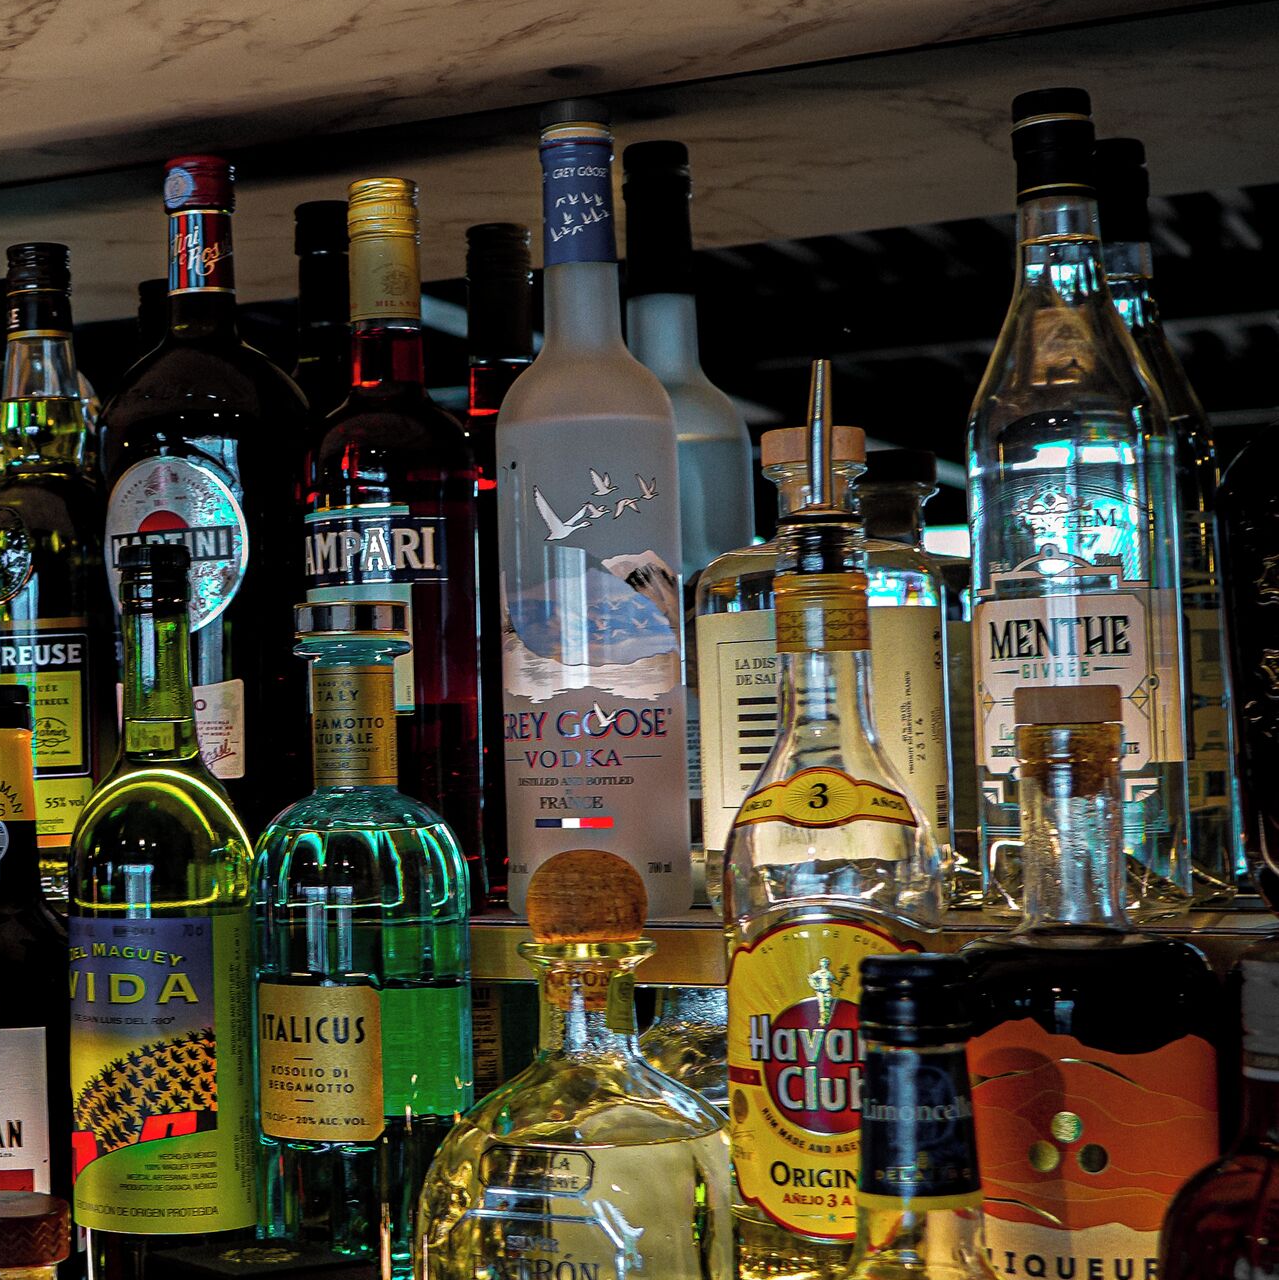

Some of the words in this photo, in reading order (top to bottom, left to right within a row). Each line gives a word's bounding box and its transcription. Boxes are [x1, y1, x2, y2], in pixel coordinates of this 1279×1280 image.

[552, 167, 575, 179] GREY
[113, 529, 228, 565] MINI
[989, 615, 1132, 660] MENTHE
[735, 658, 752, 670] LA
[736, 674, 752, 686] DE
[557, 709, 669, 742] GOOSE
[524, 750, 623, 769] VODKA
[45, 797, 66, 809] 55%
[807, 782, 830, 809] 3
[92, 942, 183, 967] MAGUEY
[262, 1013, 365, 1044] ITALICUS
[271, 1065, 325, 1078] ROSOLIO
[333, 1069, 349, 1078] DI
[269, 1080, 355, 1094] BERGAMOTTO
[778, 1126, 806, 1150] MADE
[808, 1143, 831, 1154] AND
[782, 1191, 824, 1206] AÑEJO
[827, 1194, 837, 1207] 3
[131, 1206, 165, 1217] ORIGEN
[168, 1206, 219, 1217] PROTEGIDA
